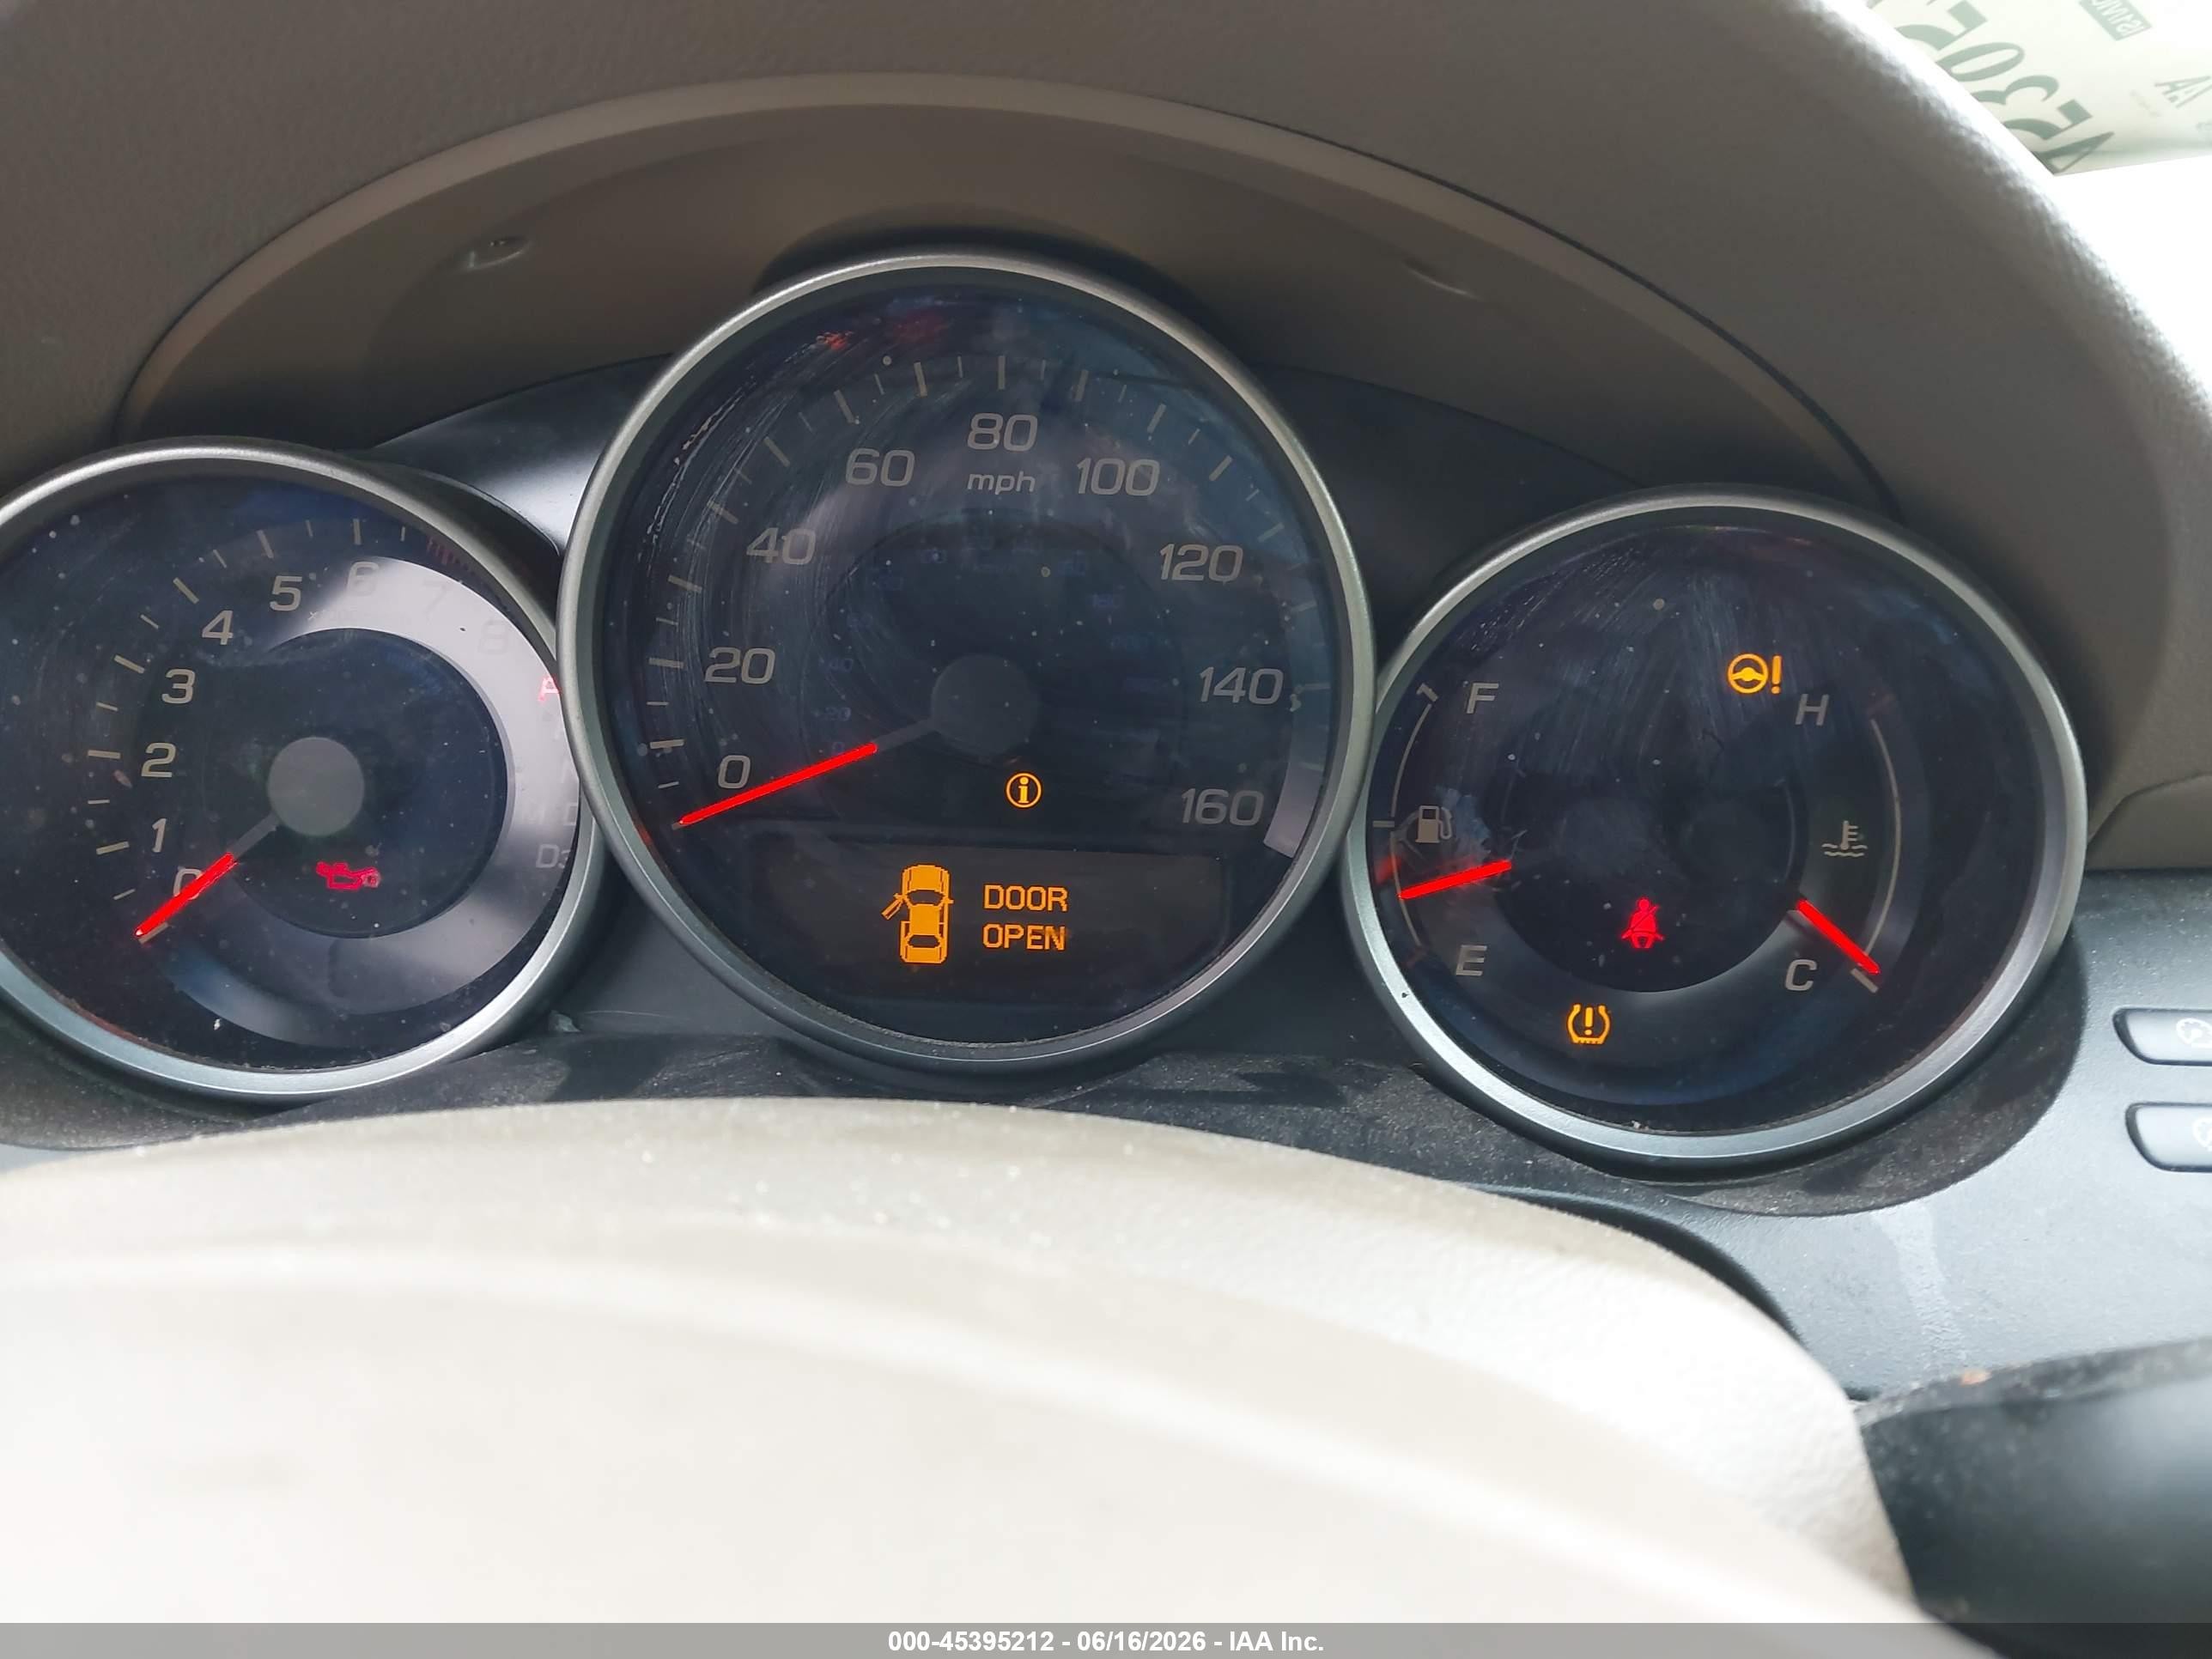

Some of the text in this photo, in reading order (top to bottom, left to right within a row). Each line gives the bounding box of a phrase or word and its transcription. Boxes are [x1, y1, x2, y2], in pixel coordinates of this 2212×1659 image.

[968, 413, 1037, 452] 80
[846, 449, 915, 487] 60
[967, 472, 1036, 495] mph
[1077, 458, 1160, 497] 100
[746, 529, 817, 565] 40
[1159, 544, 1243, 582] 120
[270, 575, 302, 611] 5
[346, 562, 380, 595] 6
[202, 611, 234, 645] 4
[704, 647, 775, 684] 20
[161, 669, 196, 704] 3
[1199, 668, 1284, 705] 140
[1466, 682, 1499, 714] F
[1795, 693, 1830, 726] H
[141, 743, 176, 777] 2
[718, 755, 751, 789] 0
[1181, 789, 1265, 826] 160
[151, 818, 167, 852] 1
[173, 867, 204, 900] 0
[982, 884, 1069, 912] DOOR
[982, 923, 1067, 951] OPEN
[1455, 945, 1488, 976] E
[1784, 959, 1817, 992] C
